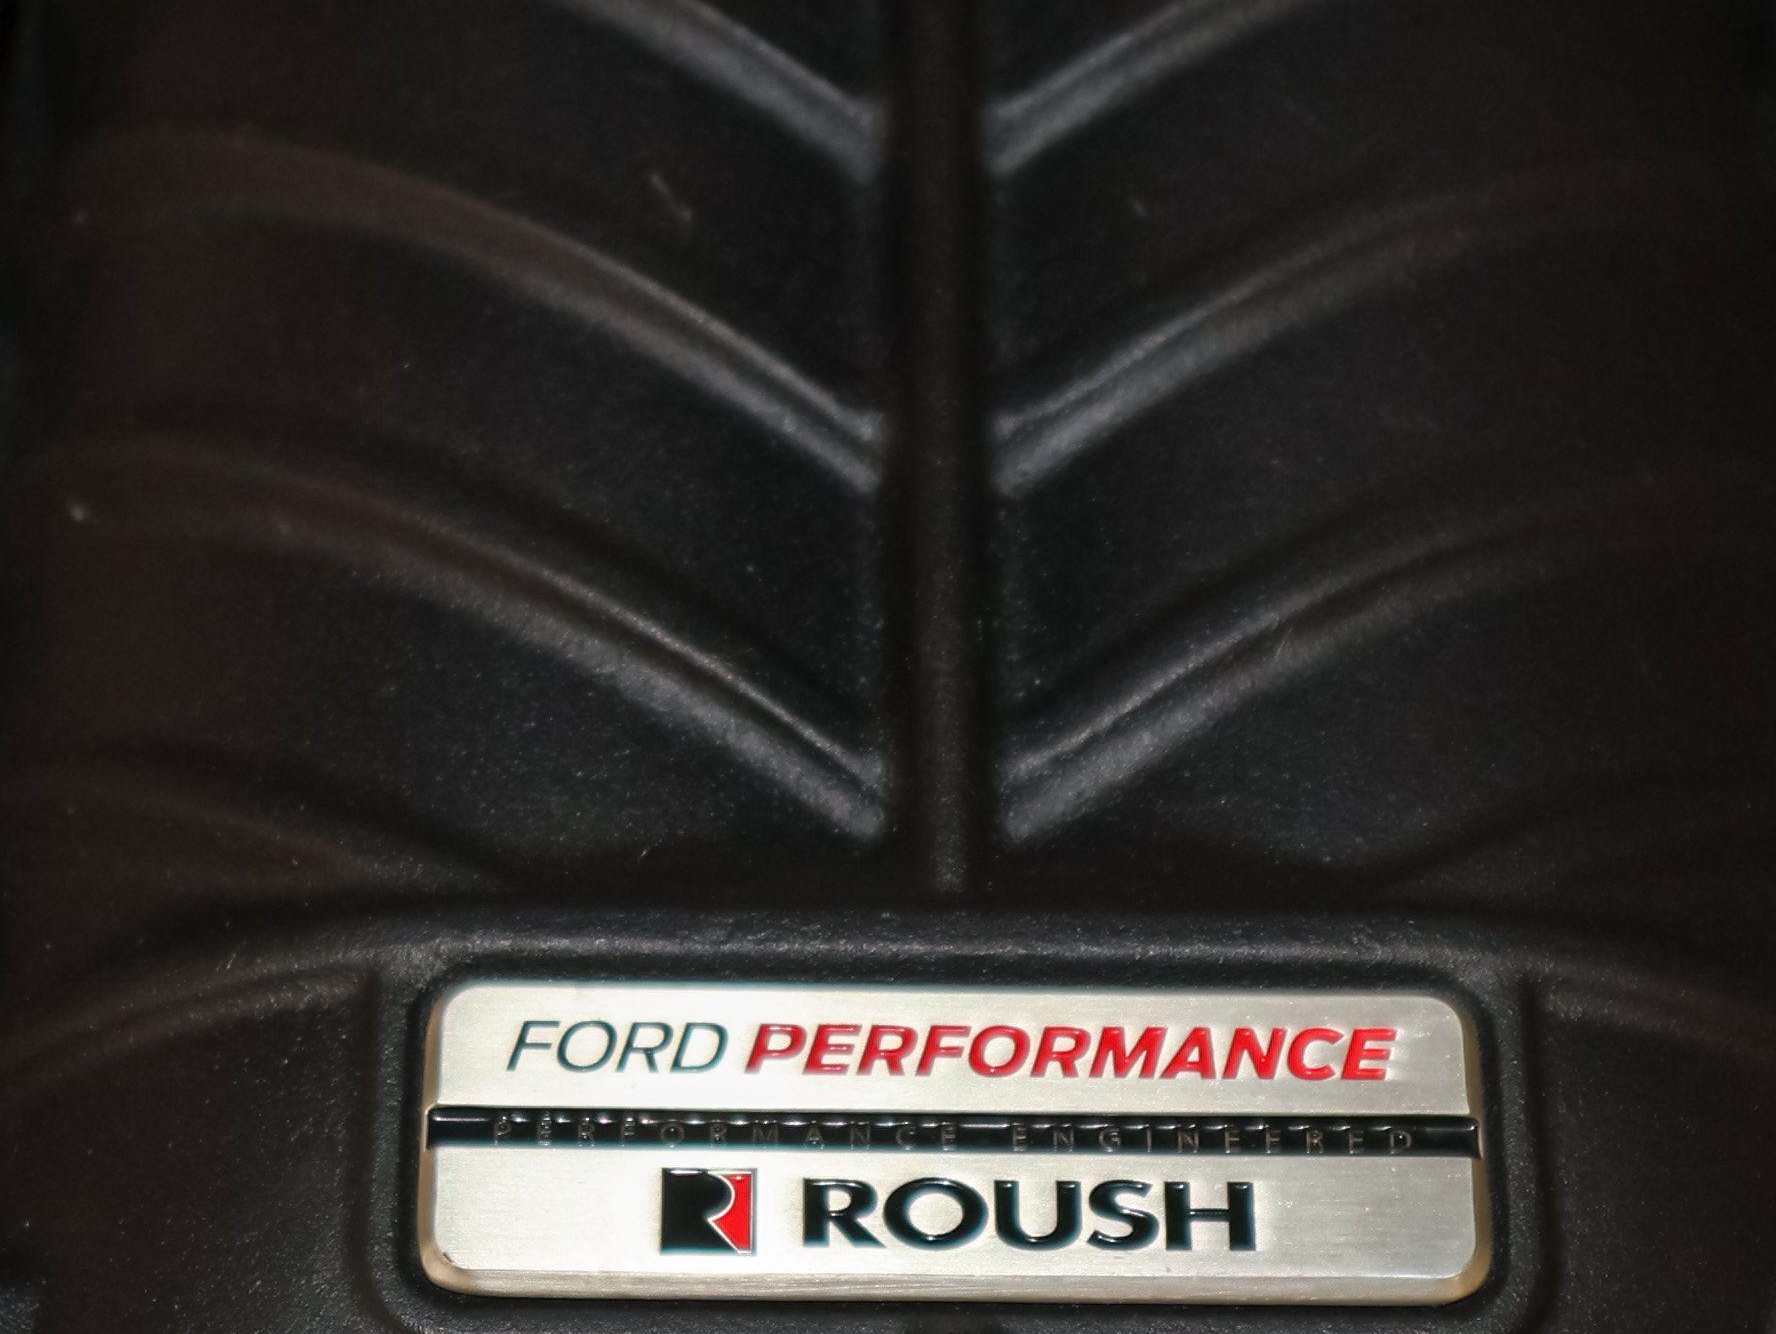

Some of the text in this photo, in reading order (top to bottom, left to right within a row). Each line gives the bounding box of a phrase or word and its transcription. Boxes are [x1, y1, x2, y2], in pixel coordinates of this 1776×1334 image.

[507, 1018, 1399, 1082] FORD PERFORMANCE
[492, 1111, 1414, 1155] PERFORMANCE ENGINEERED
[801, 1177, 1257, 1254] ROUSH
